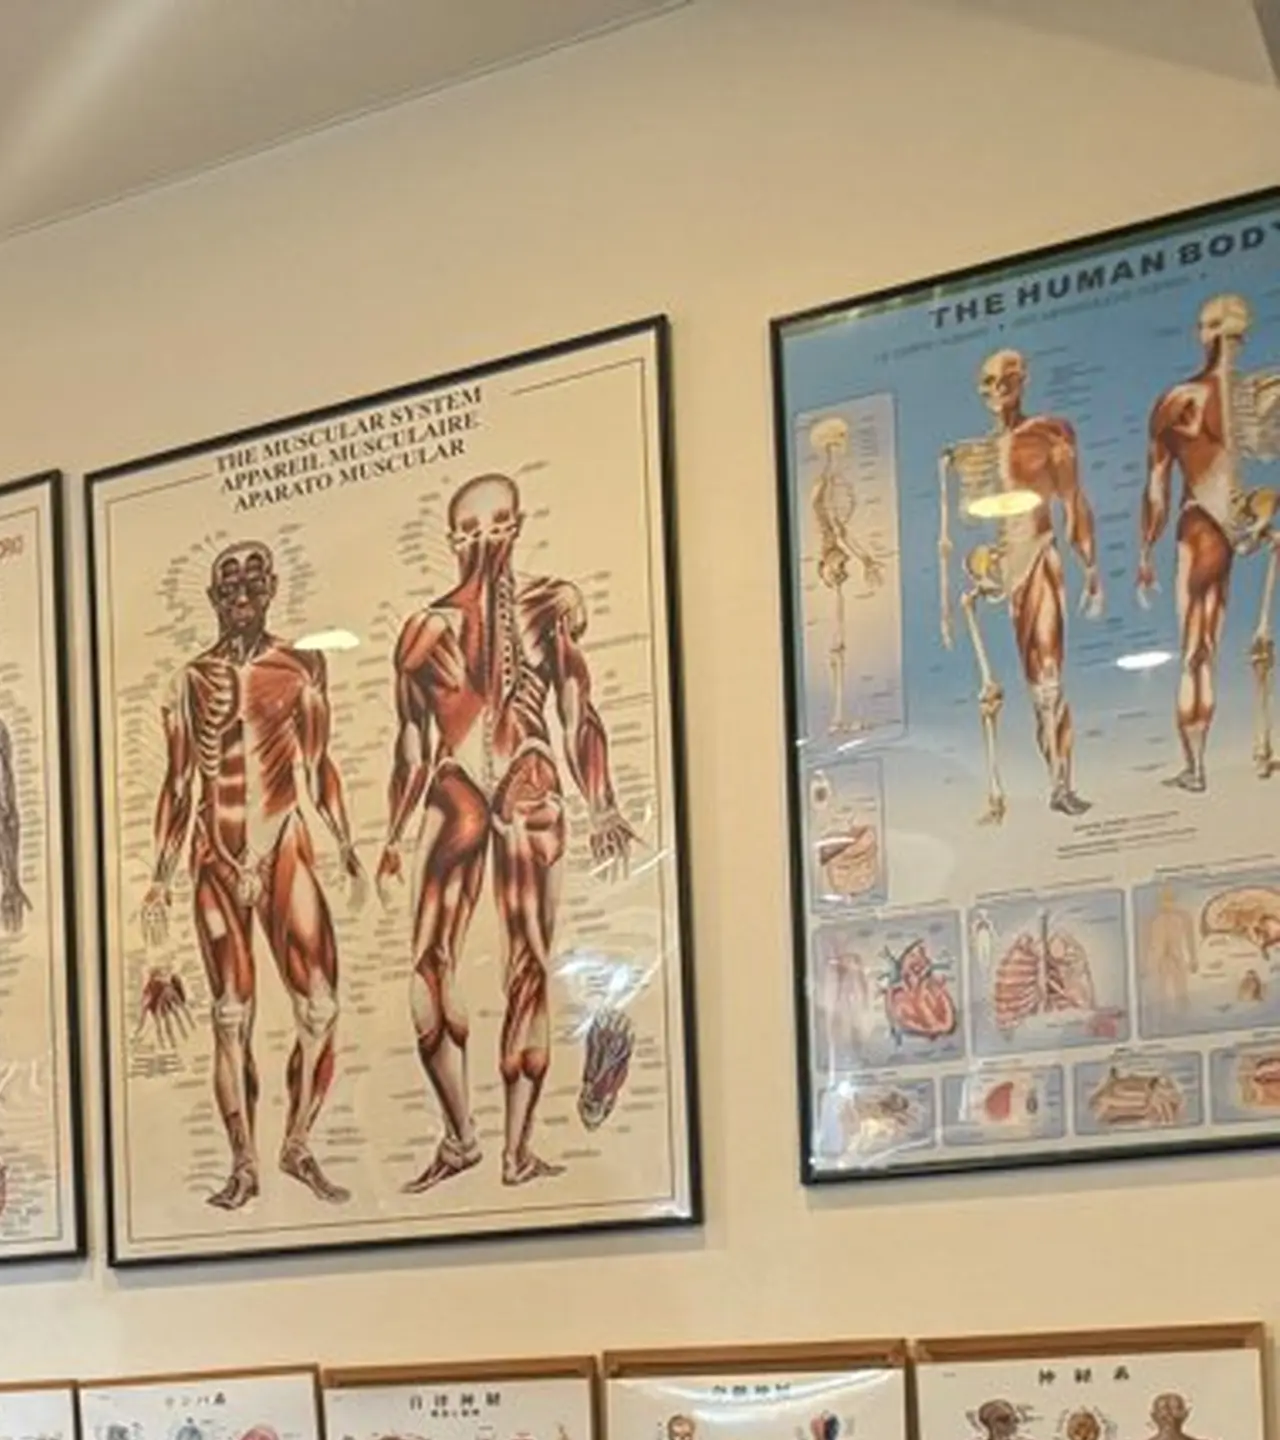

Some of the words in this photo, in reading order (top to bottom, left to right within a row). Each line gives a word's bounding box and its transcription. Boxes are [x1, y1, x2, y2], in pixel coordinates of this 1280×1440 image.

[928, 292, 1006, 329] THE
[1016, 250, 1166, 307] HUMAN
[215, 448, 258, 474] THE
[262, 411, 386, 460] MUSCULAR
[389, 385, 483, 426] SYSTEM
[221, 451, 325, 495] APPAREIL
[329, 411, 480, 466] MUSCULAIRE
[234, 475, 333, 514] APARATO
[339, 437, 466, 486] MUSCULAR
